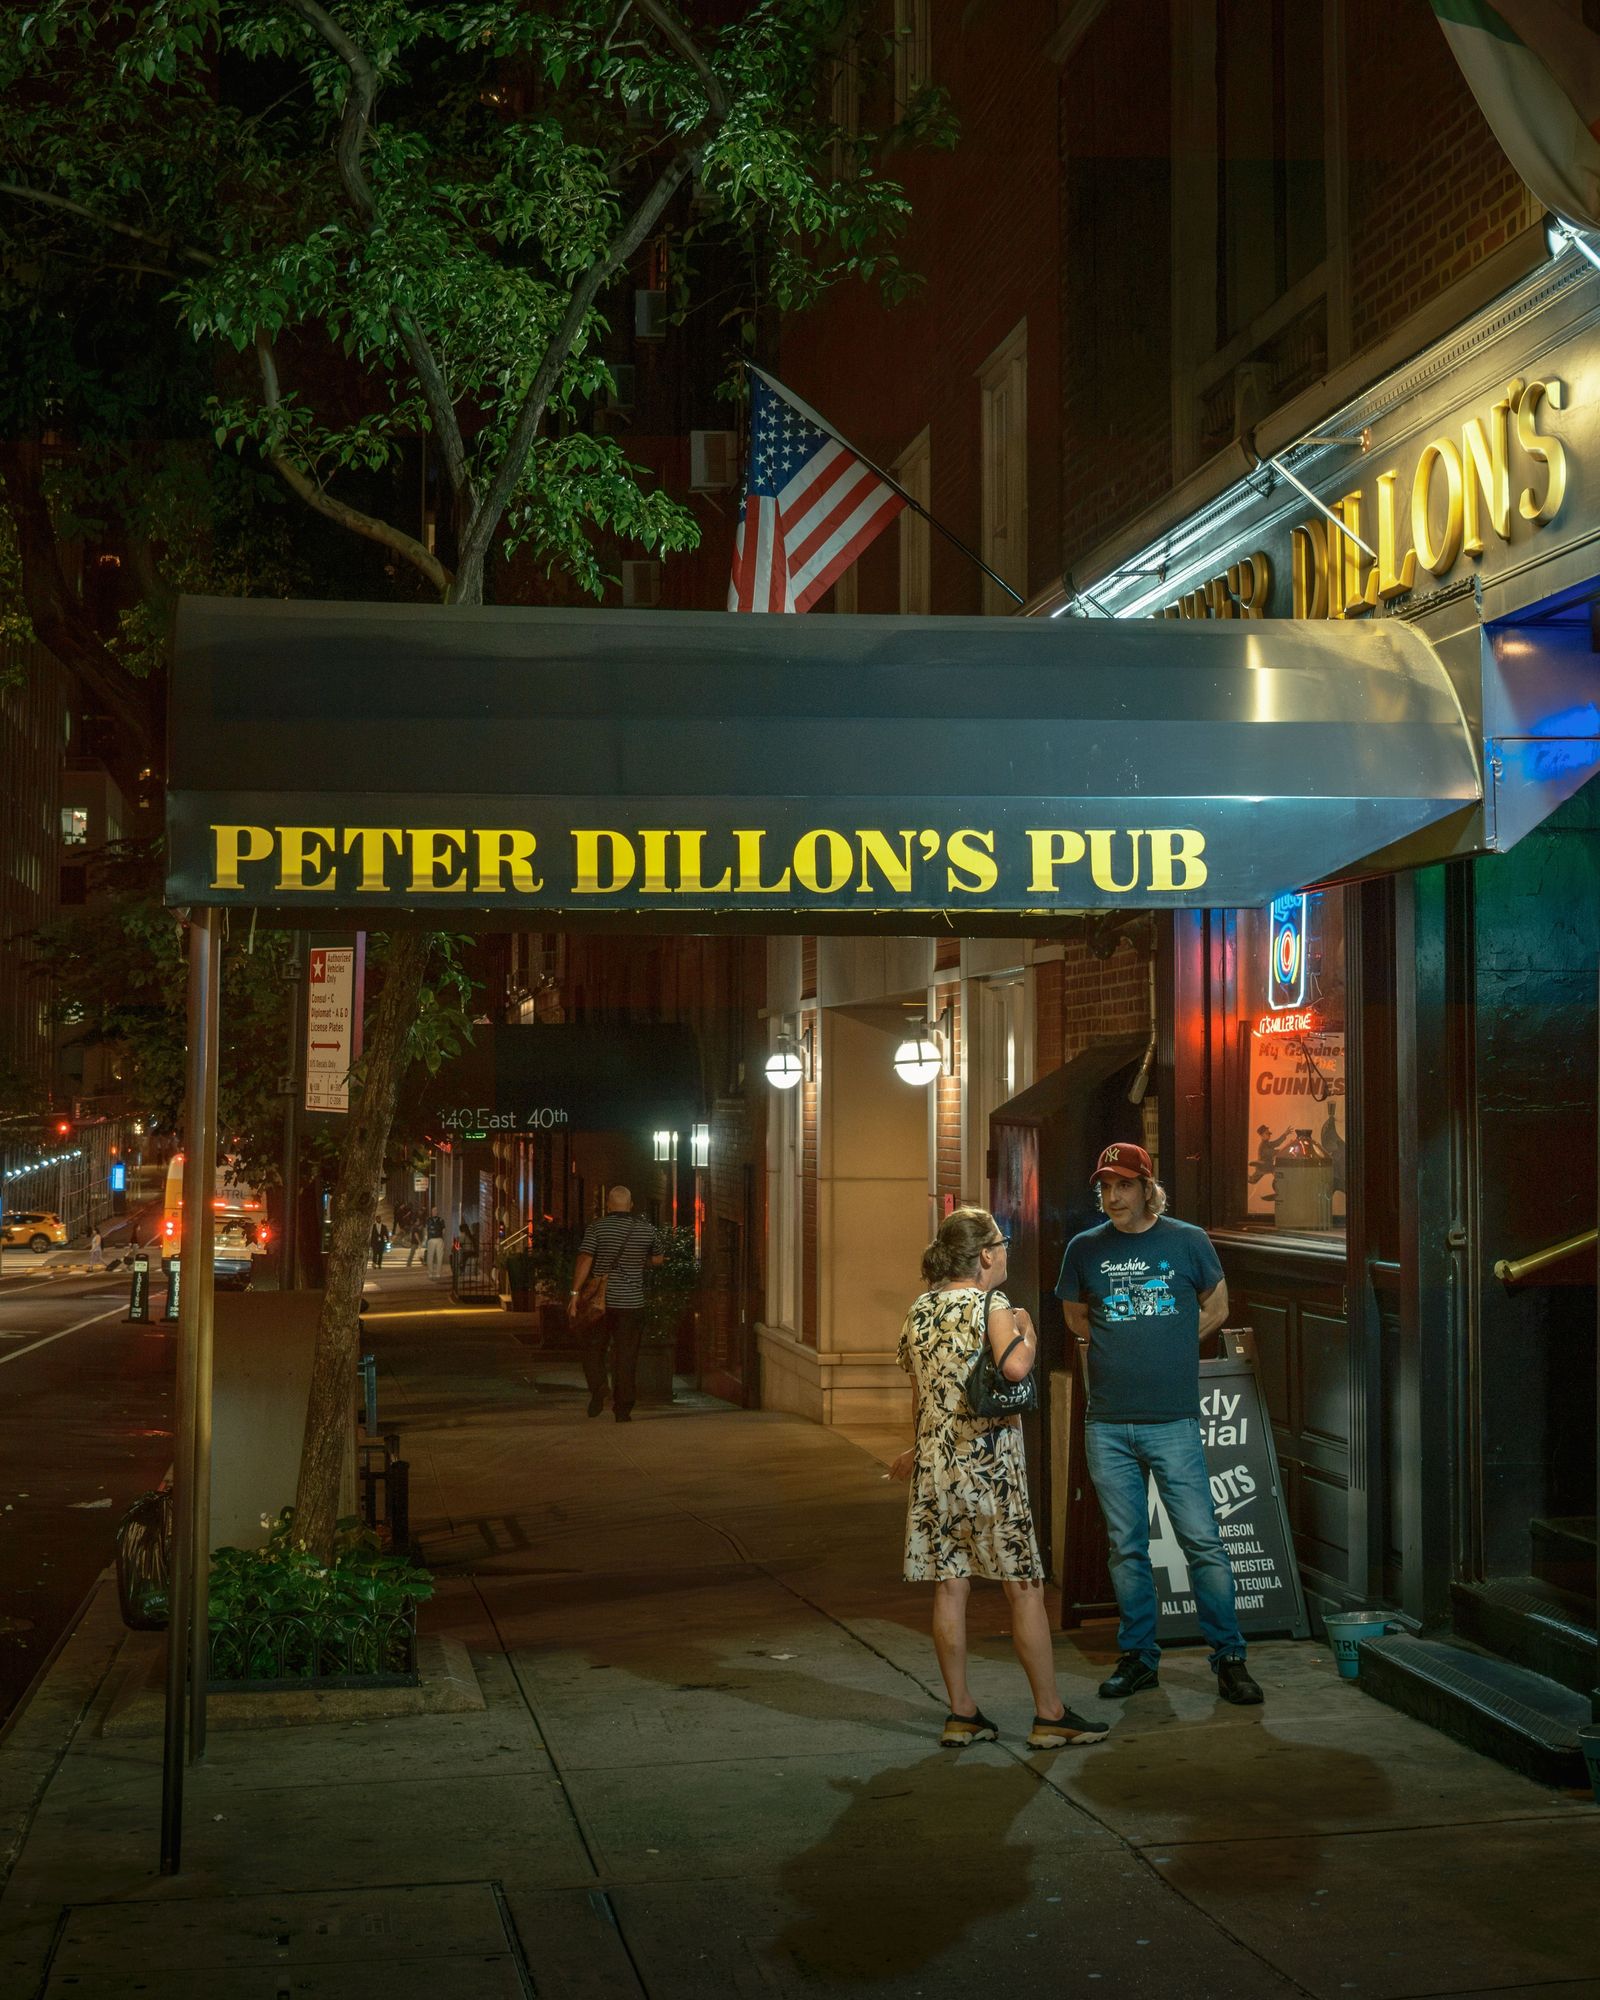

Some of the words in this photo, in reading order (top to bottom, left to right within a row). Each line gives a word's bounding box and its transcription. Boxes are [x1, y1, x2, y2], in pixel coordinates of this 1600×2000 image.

[1290, 377, 1567, 620] DILLON'S
[209, 824, 544, 893] PETER
[570, 827, 999, 894] DILLON'S
[1025, 828, 1208, 893] PUB
[327, 952, 352, 963] Authorized
[326, 965, 345, 974] Vehicles
[326, 974, 337, 984] Only
[311, 993, 327, 1004] Consul
[311, 1007, 332, 1020] Diplomat
[310, 1022, 329, 1032] License
[329, 1022, 344, 1033] Plates
[1256, 1071, 1345, 1096] GUINNES
[477, 1107, 517, 1130] East
[527, 1107, 569, 1130] 40th
[1104, 1147, 1121, 1163] NY
[1100, 1256, 1151, 1274] Sunshine
[1200, 1388, 1242, 1421] kly
[1208, 1464, 1257, 1506] OTS
[1218, 1523, 1255, 1538] MESON
[1225, 1540, 1265, 1556] EWBALL
[1230, 1558, 1275, 1573] MEISTER
[1240, 1576, 1283, 1592] TEQUILA
[1161, 1600, 1182, 1616] ALL
[1182, 1599, 1198, 1615] DA
